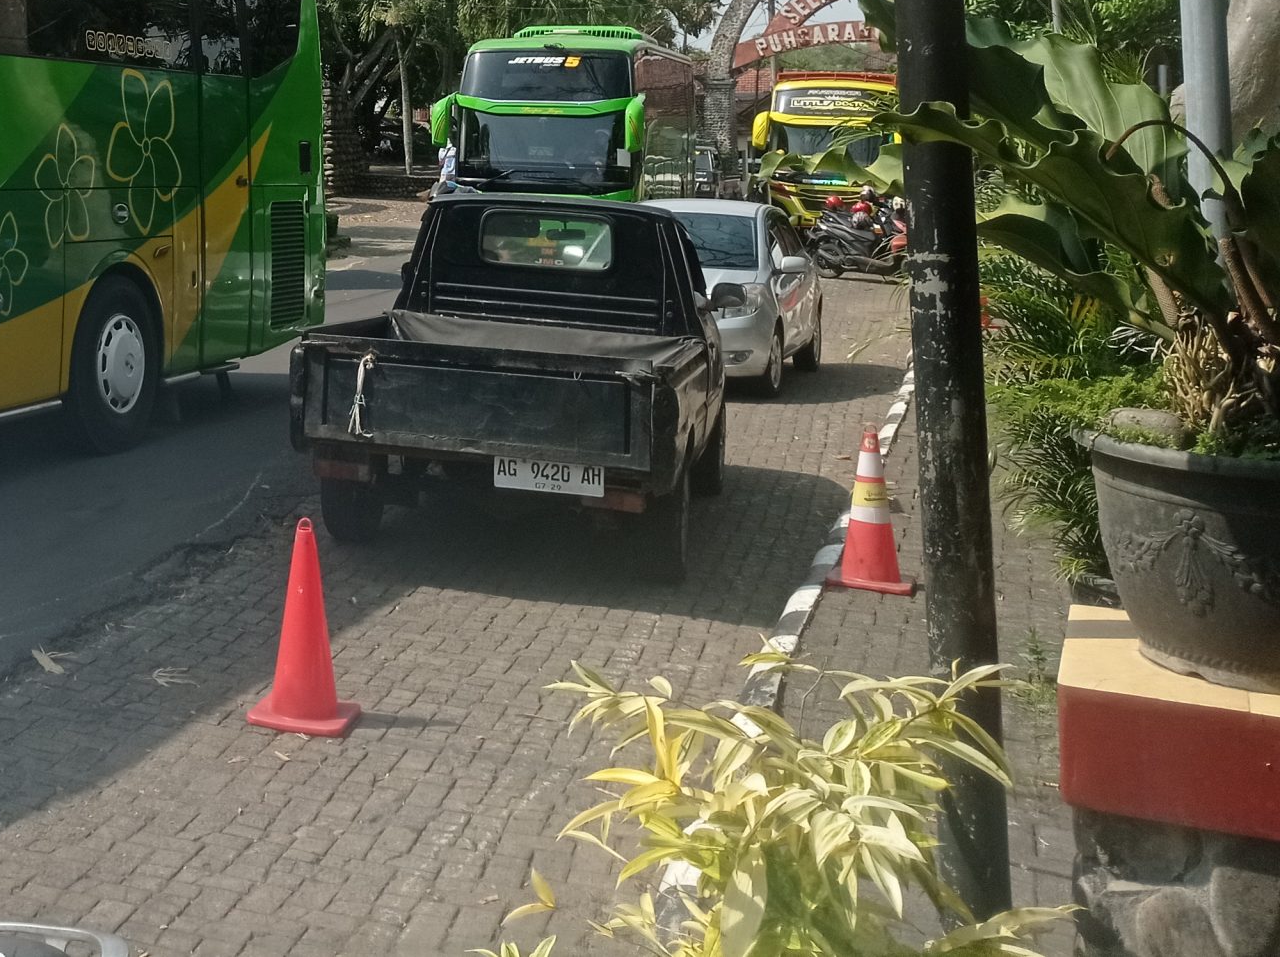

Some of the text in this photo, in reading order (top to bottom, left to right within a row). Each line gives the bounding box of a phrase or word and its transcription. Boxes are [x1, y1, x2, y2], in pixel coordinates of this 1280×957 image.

[497, 459, 601, 485] AG 9420 AH
